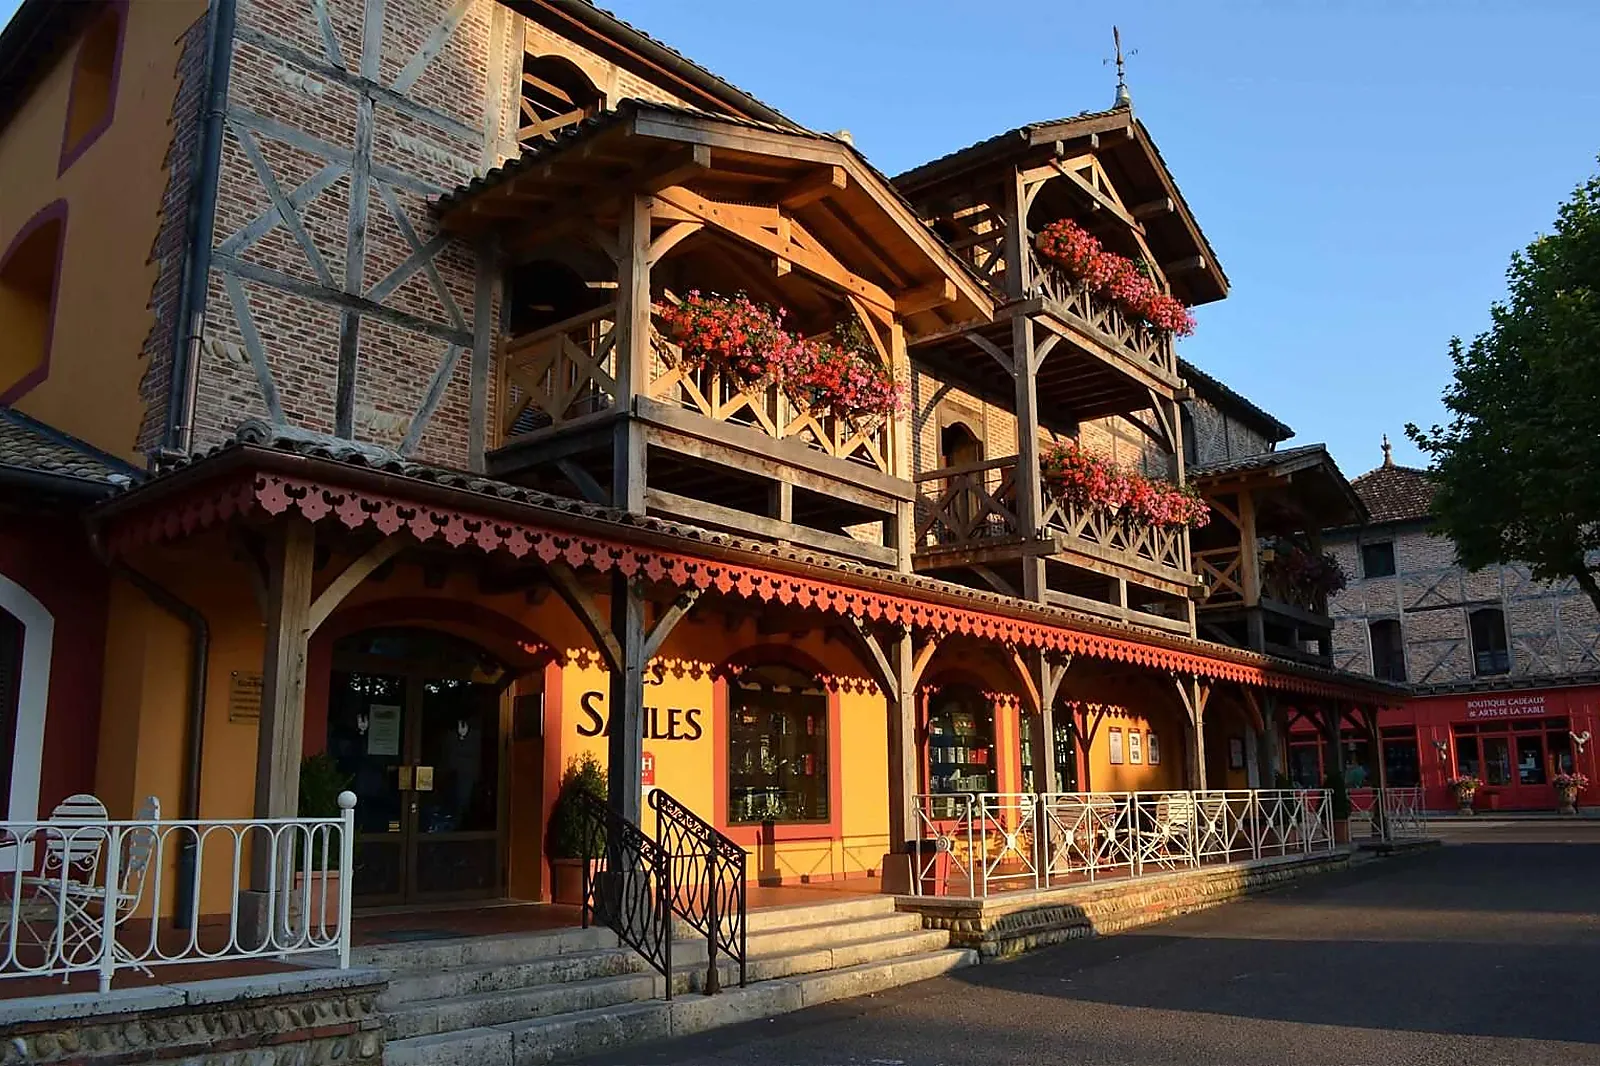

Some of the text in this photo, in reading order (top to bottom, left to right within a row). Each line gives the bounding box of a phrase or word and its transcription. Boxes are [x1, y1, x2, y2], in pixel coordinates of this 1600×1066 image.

[1467, 697, 1545, 708] BOUTIQUE CADEAUX
[1478, 708, 1498, 717] ARTS
[1499, 707, 1508, 715] DE
